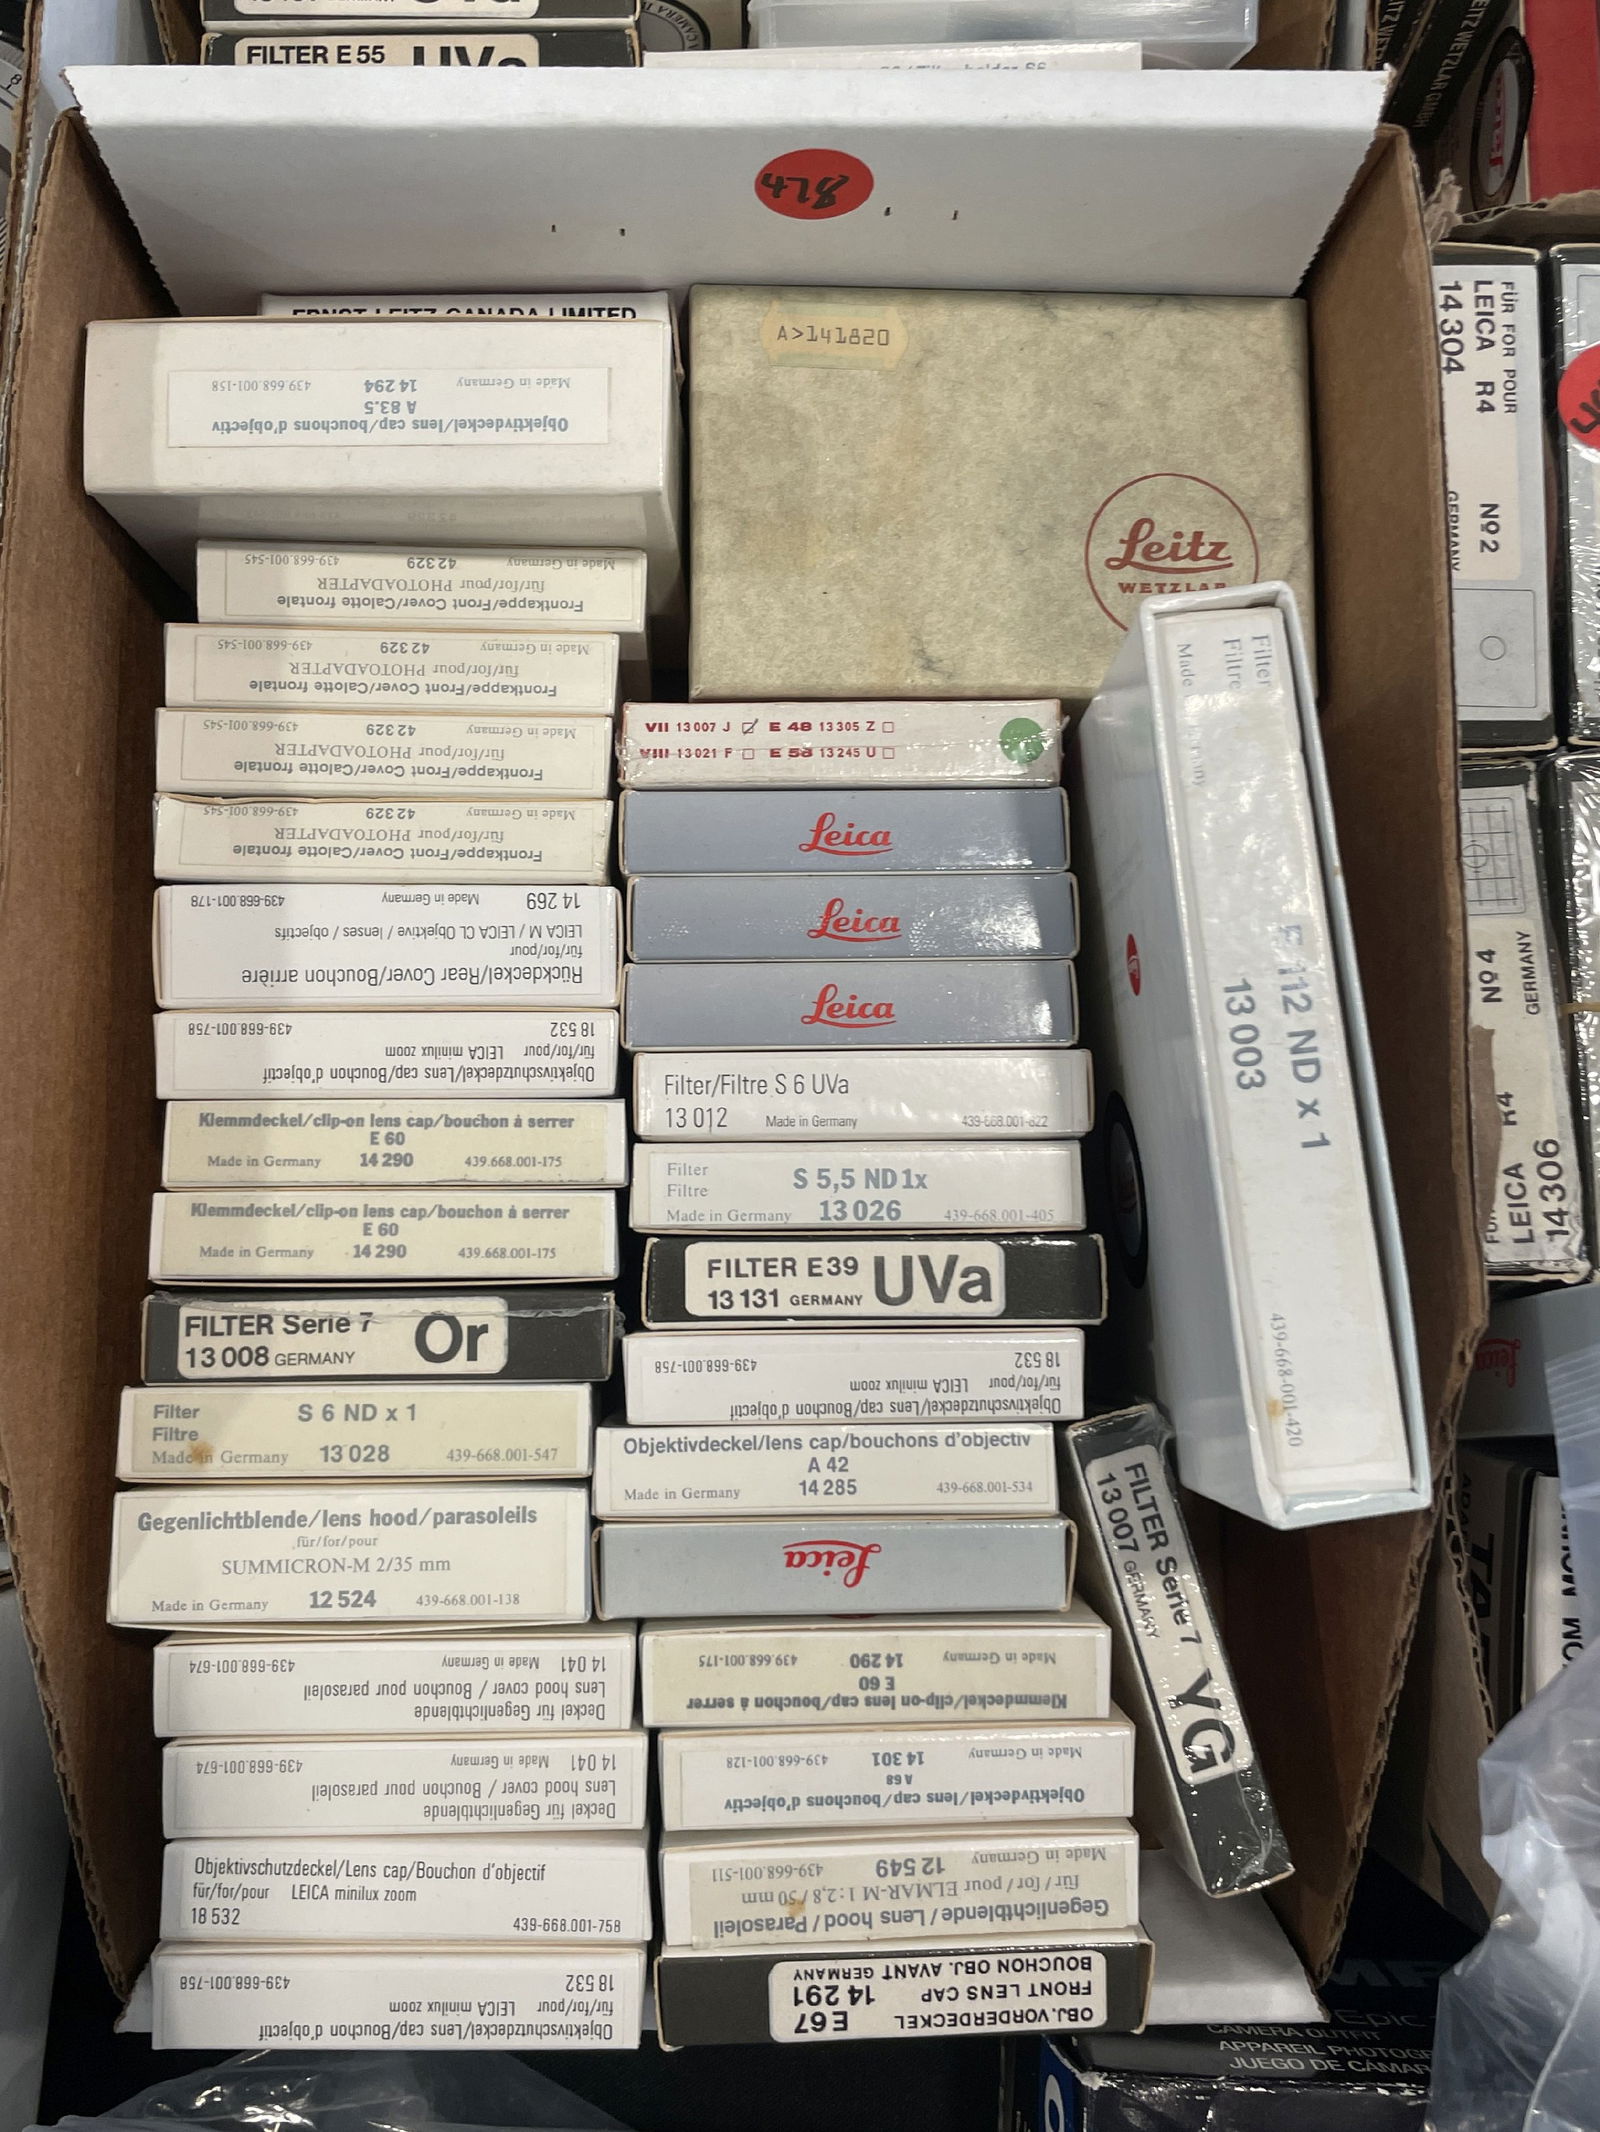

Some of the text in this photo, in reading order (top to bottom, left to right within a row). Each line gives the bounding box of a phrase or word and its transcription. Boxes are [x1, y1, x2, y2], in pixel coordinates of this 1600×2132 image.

[247, 46, 328, 64] FILTER
[760, 173, 850, 210] 478
[1474, 280, 1496, 413] LEICA R4
[1501, 282, 1518, 413] FÜR FOR POUR
[364, 401, 416, 414] A 83.5
[212, 415, 568, 434] Objektivdeckel/lens cap/bouchons d'objectiv
[1104, 518, 1234, 574] Leitz
[277, 596, 583, 612] Frontkappe/Front Cover/Calotte frontale
[288, 662, 519, 678] für/for/pour PHOTOADAPTER
[250, 680, 556, 697] Frontkappe/Front Cover/Calotte frontale
[646, 723, 668, 732] VII
[770, 722, 780, 731] E
[799, 812, 893, 856] Leica
[233, 845, 542, 862] Frontkappe/Front Cover/Calotte frontale
[382, 892, 479, 906] Made in Germany
[806, 898, 902, 942] Leica
[242, 965, 582, 987] Rückdeckel/Rear Cover/Bouchon arrière
[801, 984, 896, 1028] Leica
[262, 1063, 594, 1084] Objektivschutzdeckel/Lens cap/Bouchon d'objectif
[665, 1074, 768, 1098] Filter/Filtre
[775, 1074, 786, 1094] S
[812, 1074, 848, 1094] UVa
[199, 1112, 574, 1130] Klemmdeckel/clip-on lens cap/bouchon serrer
[766, 1115, 858, 1130] Made in Germany
[370, 1132, 380, 1145] E
[793, 1168, 808, 1189] S
[817, 1168, 855, 1193] 5,5
[865, 1168, 897, 1189] ND
[708, 1257, 796, 1278] FILTER
[874, 1255, 992, 1306] UVa
[790, 1294, 862, 1306] GERMANY
[186, 1314, 274, 1337] FILTER
[282, 1315, 350, 1334] Serie
[415, 1316, 488, 1363] Or
[275, 1352, 355, 1366] GERMANY
[154, 1404, 200, 1419] Filter
[298, 1404, 312, 1422] S
[344, 1404, 377, 1422] ND
[386, 1408, 398, 1421] x
[152, 1427, 199, 1442] Filtre
[624, 1432, 1031, 1457] Objektivdeckel/lens cap/bouchons d'objectiv
[808, 1457, 820, 1473] A
[138, 1506, 537, 1534] Gegenlichtblende/lens hood/parasoleils
[297, 1535, 378, 1548] für/for/pour
[1125, 1463, 1169, 1552] FILTER
[1158, 1556, 1191, 1627] Serie
[222, 1556, 450, 1575] SUMMICRON-M 2/35 mm
[783, 1540, 881, 1588] Leica
[414, 1701, 605, 1722] Deckel für Gegenlichtblende
[1167, 1669, 1236, 1772] YG
[724, 1786, 1084, 1813] Objektivdeckel/lens cap/bouchons d'objectiv
[195, 1857, 546, 1884] Objektivschutzdeckel/Lens cap/Bouchon d'objectif
[194, 1882, 416, 1902] für/for/pour LEICA minilux zoom
[714, 1897, 1109, 1938] Gegenlichtblende Lens hood Parasoleil
[794, 1956, 1091, 1980] BOUCHON OBJ. AVANT GERMANY
[921, 1980, 1091, 2002] FRONT LENS CAP
[259, 2020, 612, 2041] Objektivschutzdeckel/Lens cap/Bouchon d'objectif
